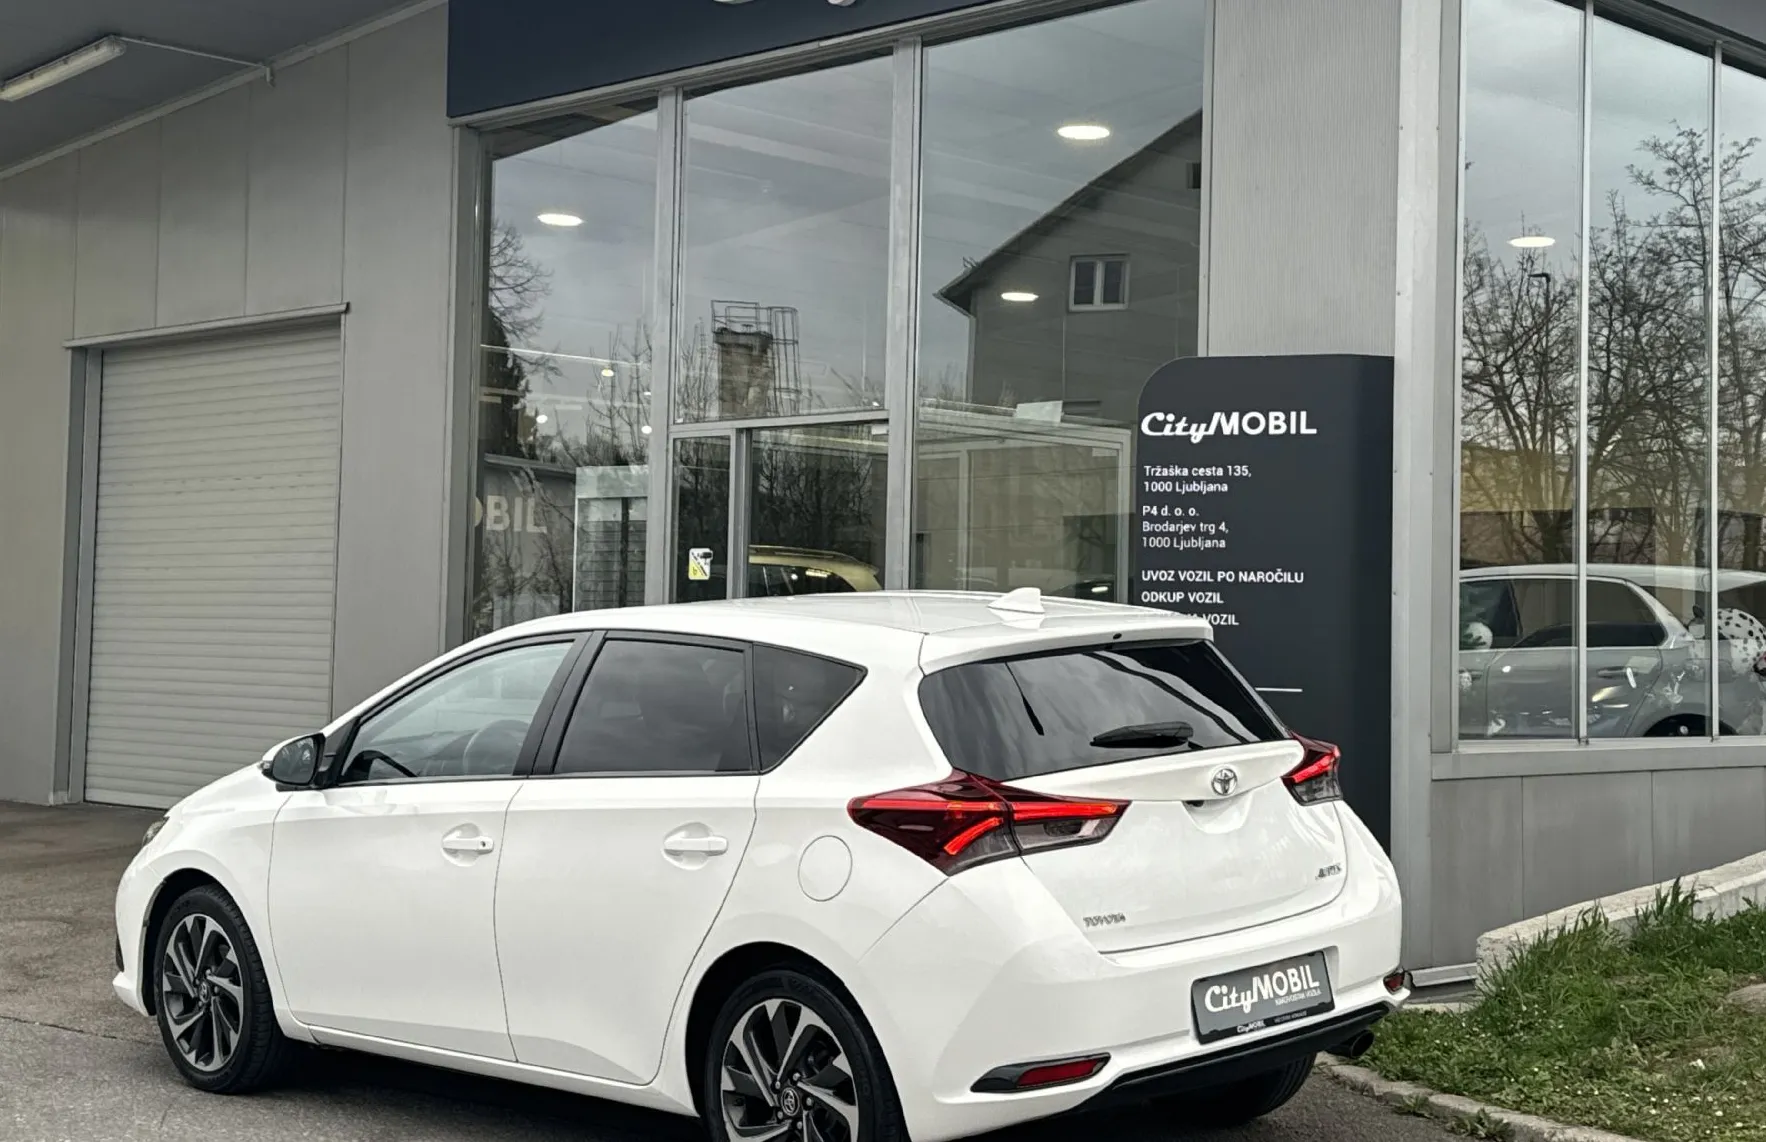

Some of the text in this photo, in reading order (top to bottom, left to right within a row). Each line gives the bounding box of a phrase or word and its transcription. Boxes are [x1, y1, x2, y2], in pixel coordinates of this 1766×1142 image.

[1141, 411, 1318, 444] CityMOBIL
[1144, 465, 1252, 478] Tržaška cesta 135,
[1144, 481, 1228, 494] 1000 Ljubljana
[1142, 505, 1200, 516] P4 d. o. o.
[1142, 521, 1229, 535] Brodarjev trg 4,
[1142, 537, 1226, 550] 1000 Ljubljana
[1141, 568, 1304, 583] UVOZ VOZIL PO NAROČILU
[1141, 591, 1224, 603] ODKUP VOZIL
[1204, 964, 1320, 1013] CityMOBIL
